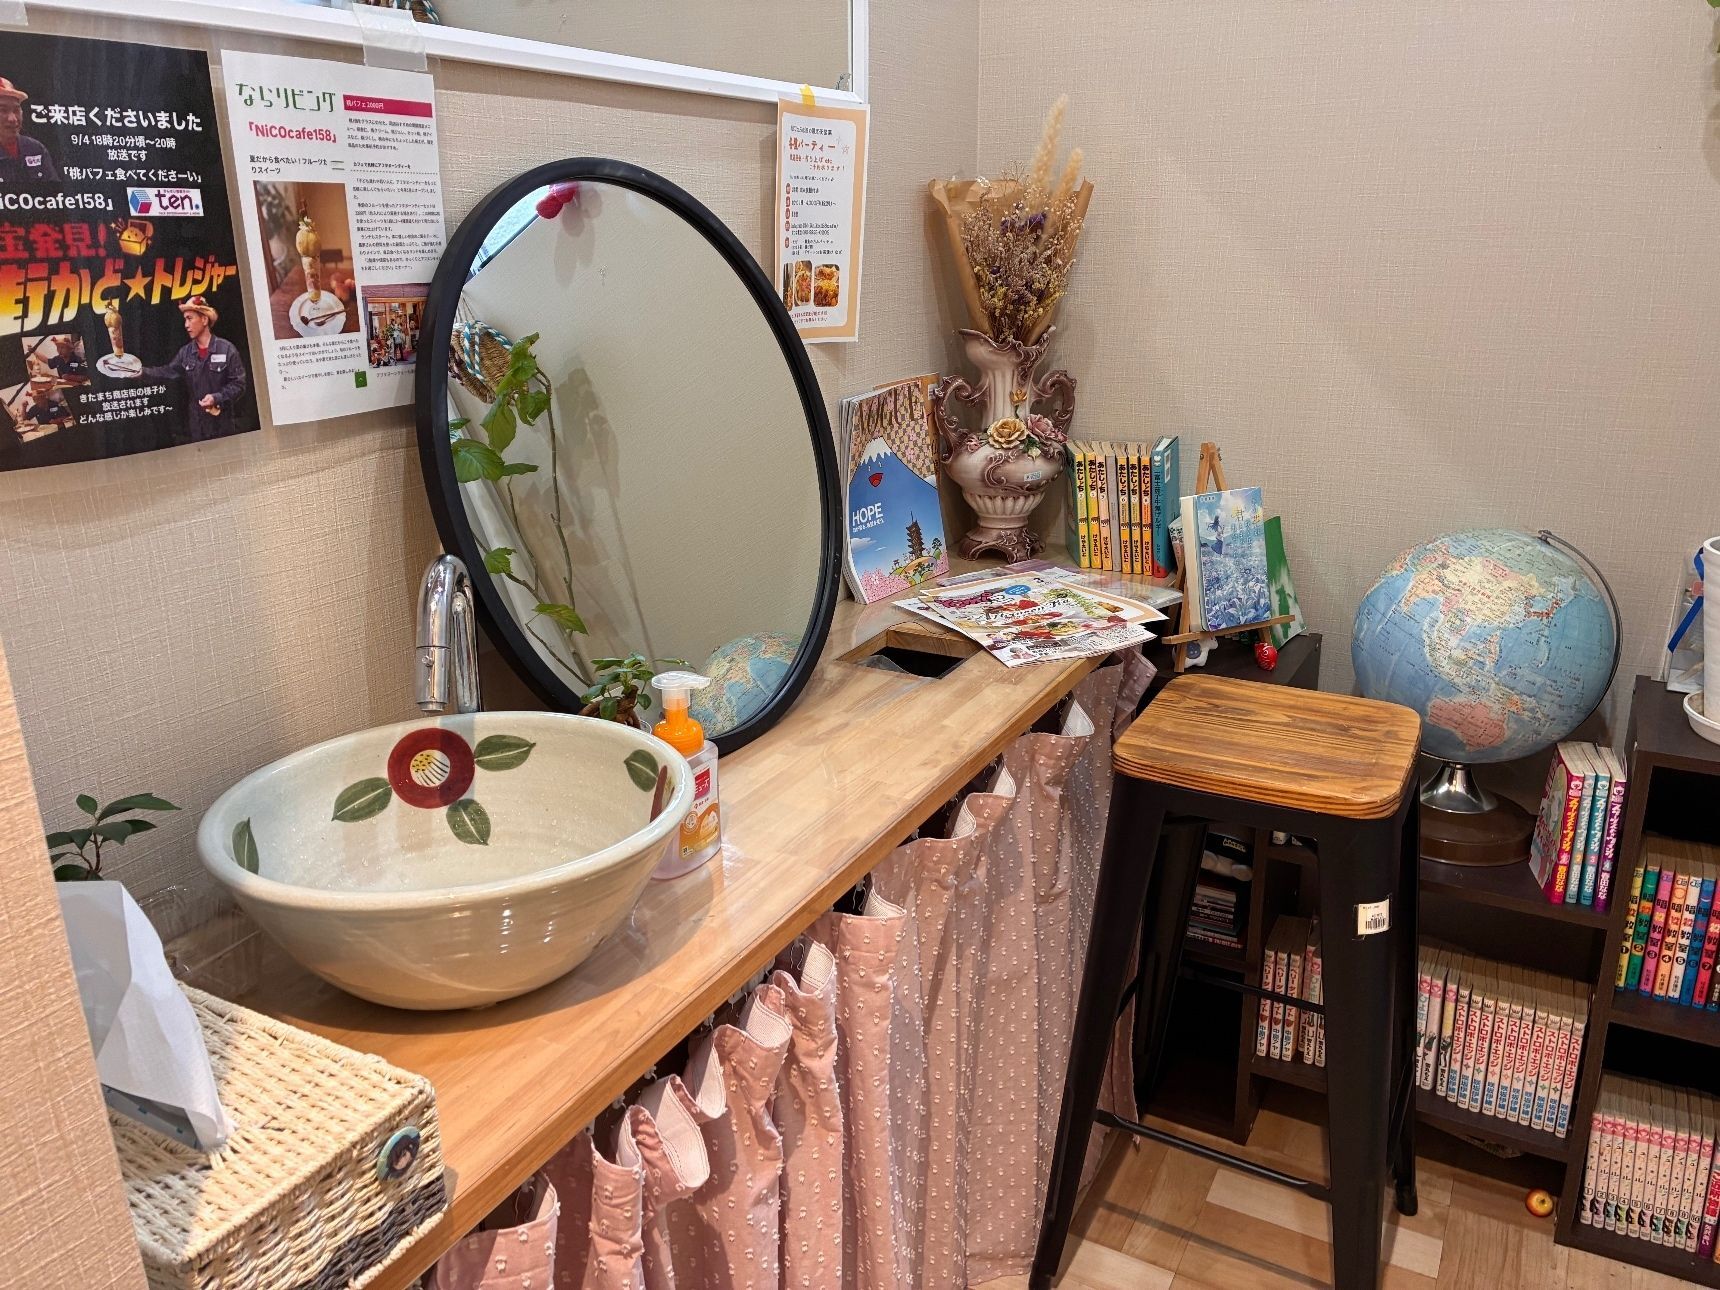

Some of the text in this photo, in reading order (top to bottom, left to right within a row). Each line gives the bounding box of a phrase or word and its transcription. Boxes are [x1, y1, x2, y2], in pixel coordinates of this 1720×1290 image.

[30, 104, 203, 131] ご来店くださいました
[235, 83, 336, 112] ならリビング
[71, 134, 90, 146] 9/4
[107, 149, 148, 161] 放送です
[79, 385, 167, 403] きたまち商店街の様子が
[102, 398, 149, 411] 放送されます
[852, 502, 884, 527] HOPE
[1664, 903, 1682, 951] 暗殺教室
[1678, 905, 1696, 953] 暗殺教室
[1453, 1005, 1465, 1055] ストロボ・エッジ
[1464, 1010, 1478, 1061] ストロボ・エッジ
[1477, 1014, 1490, 1065] ストロボ・エッジ
[1490, 1016, 1505, 1067] ストロボ・エッジ
[1503, 1019, 1518, 1071] ストロボ・エッジ
[1516, 1022, 1531, 1074] ストロボ・エッジ
[1528, 1026, 1544, 1077] ストロボ・エッジ
[1541, 1030, 1556, 1082] ストロボ・エッジ
[1553, 1032, 1568, 1084] ストロボ・エッジ
[1564, 1037, 1580, 1089] ストロボ・エッジ
